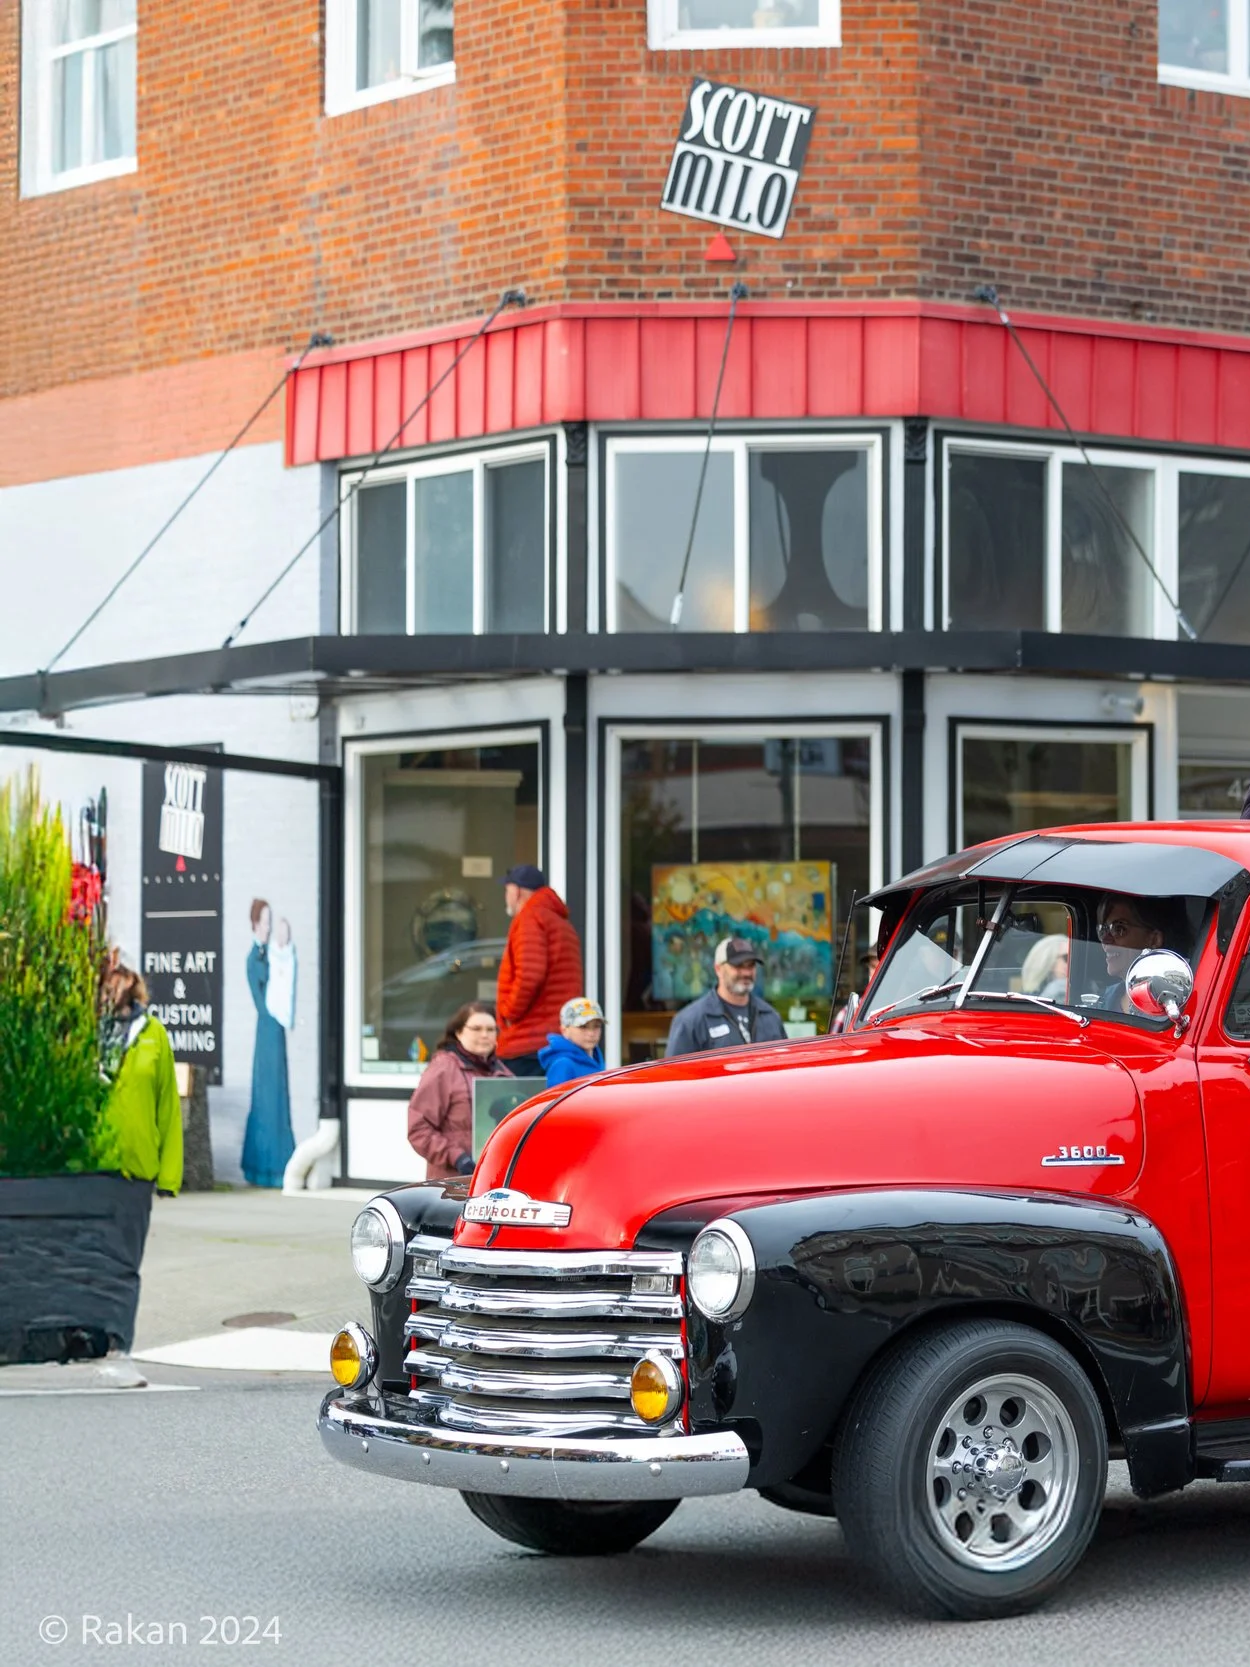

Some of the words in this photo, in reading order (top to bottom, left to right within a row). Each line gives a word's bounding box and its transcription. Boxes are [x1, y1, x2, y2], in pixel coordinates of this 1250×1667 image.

[683, 81, 812, 166] SCOTT
[666, 150, 787, 229] MILO
[144, 952, 181, 973] FINE
[184, 951, 216, 973] ART
[173, 977, 186, 999] &
[147, 1003, 213, 1025] CUSTOM
[1058, 1146, 1106, 1158] 3600
[467, 1205, 542, 1220] CHEVROLET
